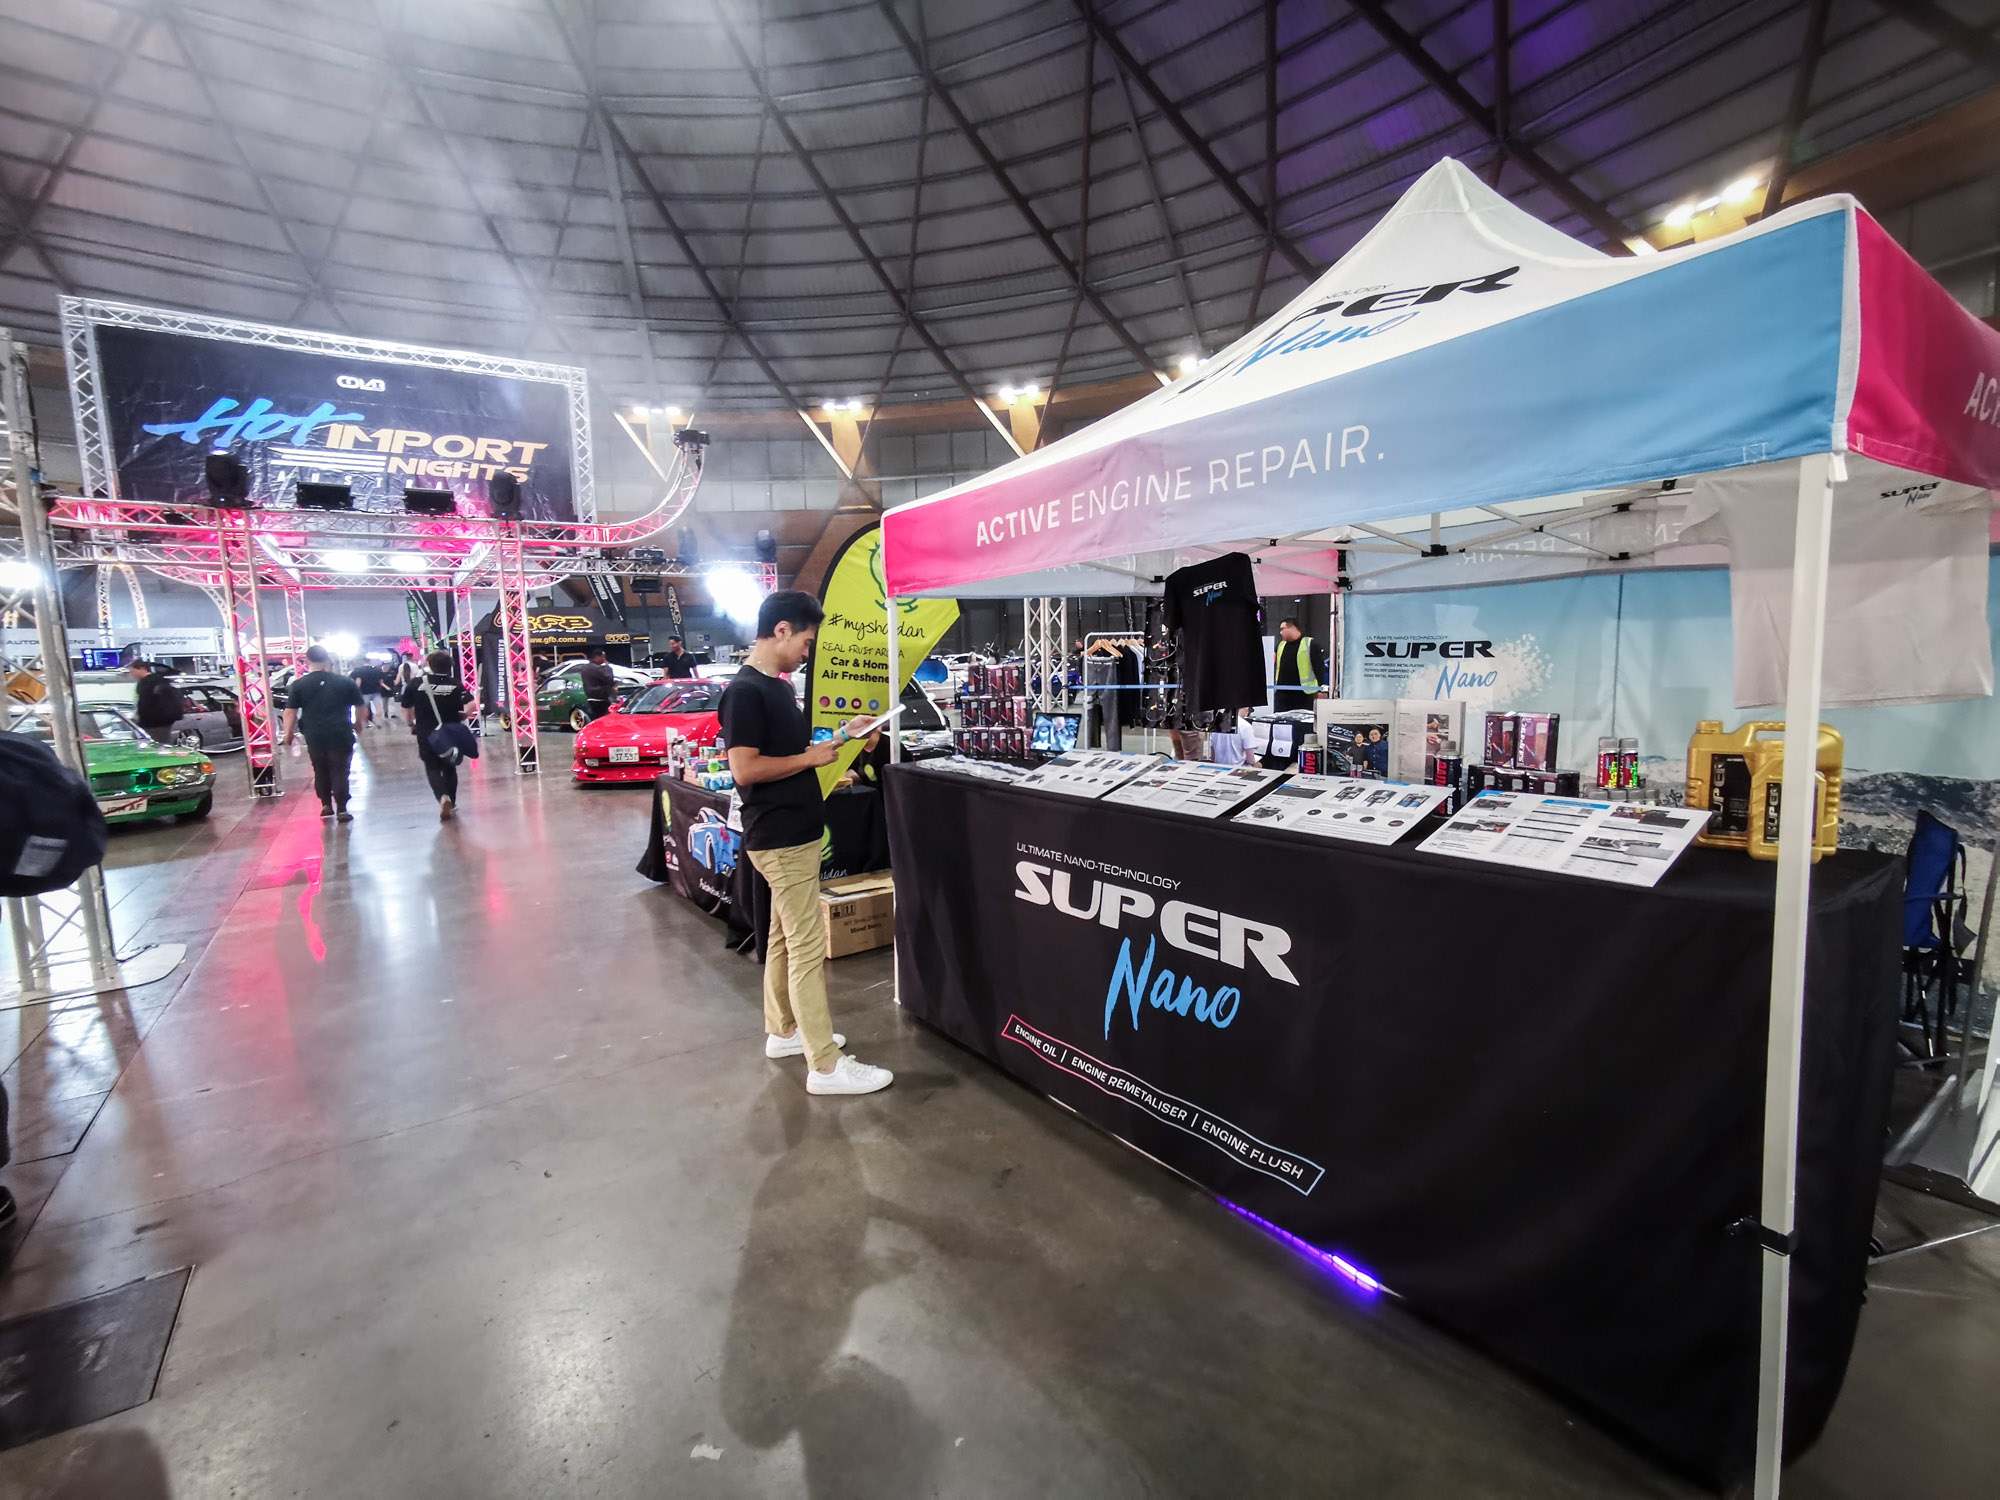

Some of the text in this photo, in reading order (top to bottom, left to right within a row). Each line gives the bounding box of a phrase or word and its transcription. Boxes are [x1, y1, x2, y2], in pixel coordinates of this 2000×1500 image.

[1233, 311, 1421, 377] Nano
[141, 397, 365, 448] Hot
[325, 423, 549, 465] IMPORT
[387, 456, 531, 483] NIGHTS
[976, 424, 1385, 547] ACTIVE ENGINE REPAIR.
[1880, 481, 1940, 499] SUPER
[1192, 581, 1228, 598] SUPER
[822, 641, 845, 653] REAL
[848, 644, 873, 655] FRUIT
[830, 656, 889, 670] Car & Hom
[1364, 640, 1496, 659] SUPER
[822, 669, 838, 679] Air
[1434, 661, 1498, 701] Nano
[1768, 787, 1779, 834] SUPER
[1016, 842, 1182, 891] ULTIMATE NANO-TECHNOLOGY
[1014, 860, 1300, 986] SUPER
[1104, 933, 1241, 1041] Nano
[1014, 1024, 1058, 1058] ENGINE OIL
[1071, 1056, 1187, 1121] ENGINE REMETALISER
[1201, 1120, 1304, 1180] ENGINE FLUSH
